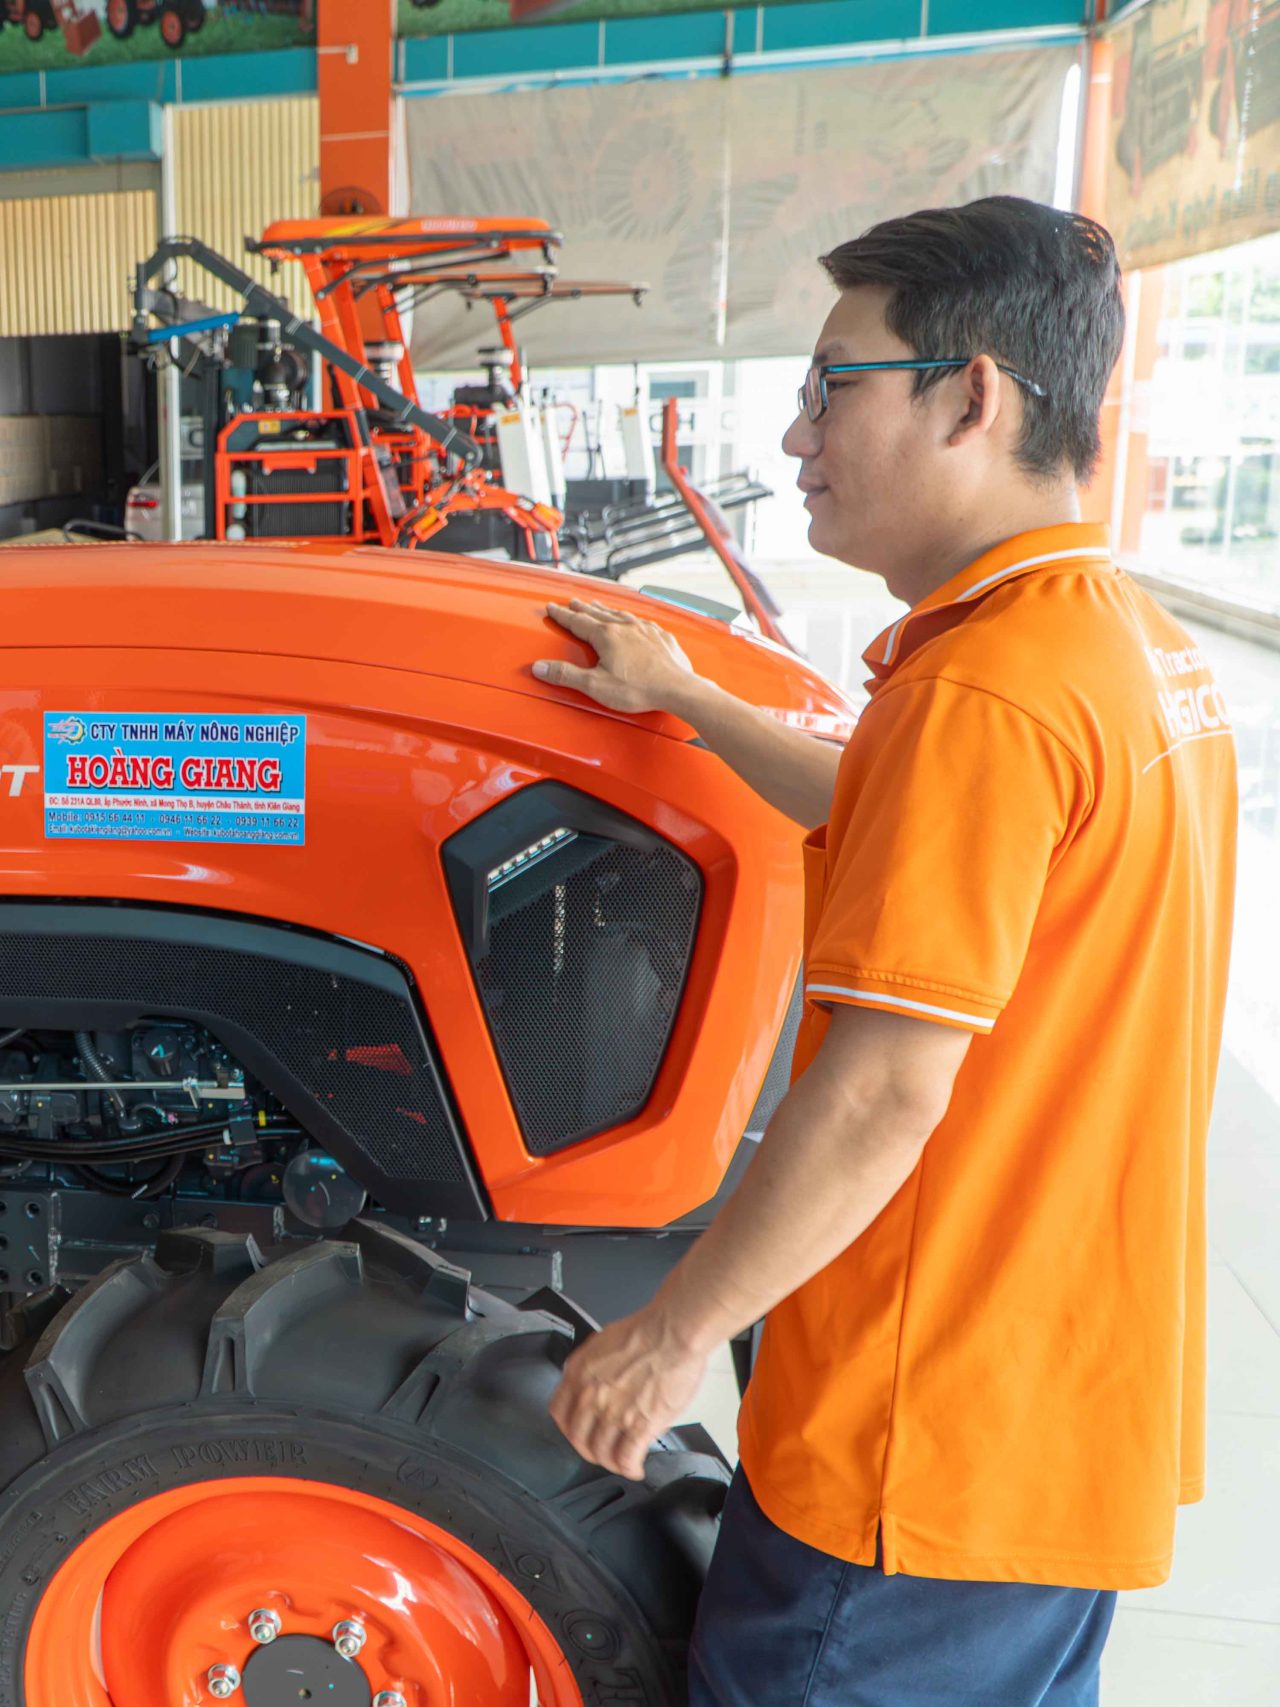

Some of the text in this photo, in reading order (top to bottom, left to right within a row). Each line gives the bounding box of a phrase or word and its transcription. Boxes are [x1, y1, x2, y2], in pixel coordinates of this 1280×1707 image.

[91, 721, 299, 746] CTY TNHH MÁY NÔNG NGHIỆP
[67, 748, 282, 792] HOÀNG GIANG
[282, 802, 300, 812] Giang
[84, 812, 106, 822] 0915
[109, 813, 119, 822] 66
[123, 813, 132, 822] 44
[136, 814, 145, 823] 11
[159, 814, 181, 824] 0946
[184, 815, 193, 824] 11
[197, 816, 207, 825] 66
[211, 816, 221, 825] 22
[236, 816, 257, 826] 0939
[261, 817, 270, 827] 11
[274, 817, 284, 827] 66
[288, 818, 298, 828] 22
[171, 1439, 309, 1470] POWER
